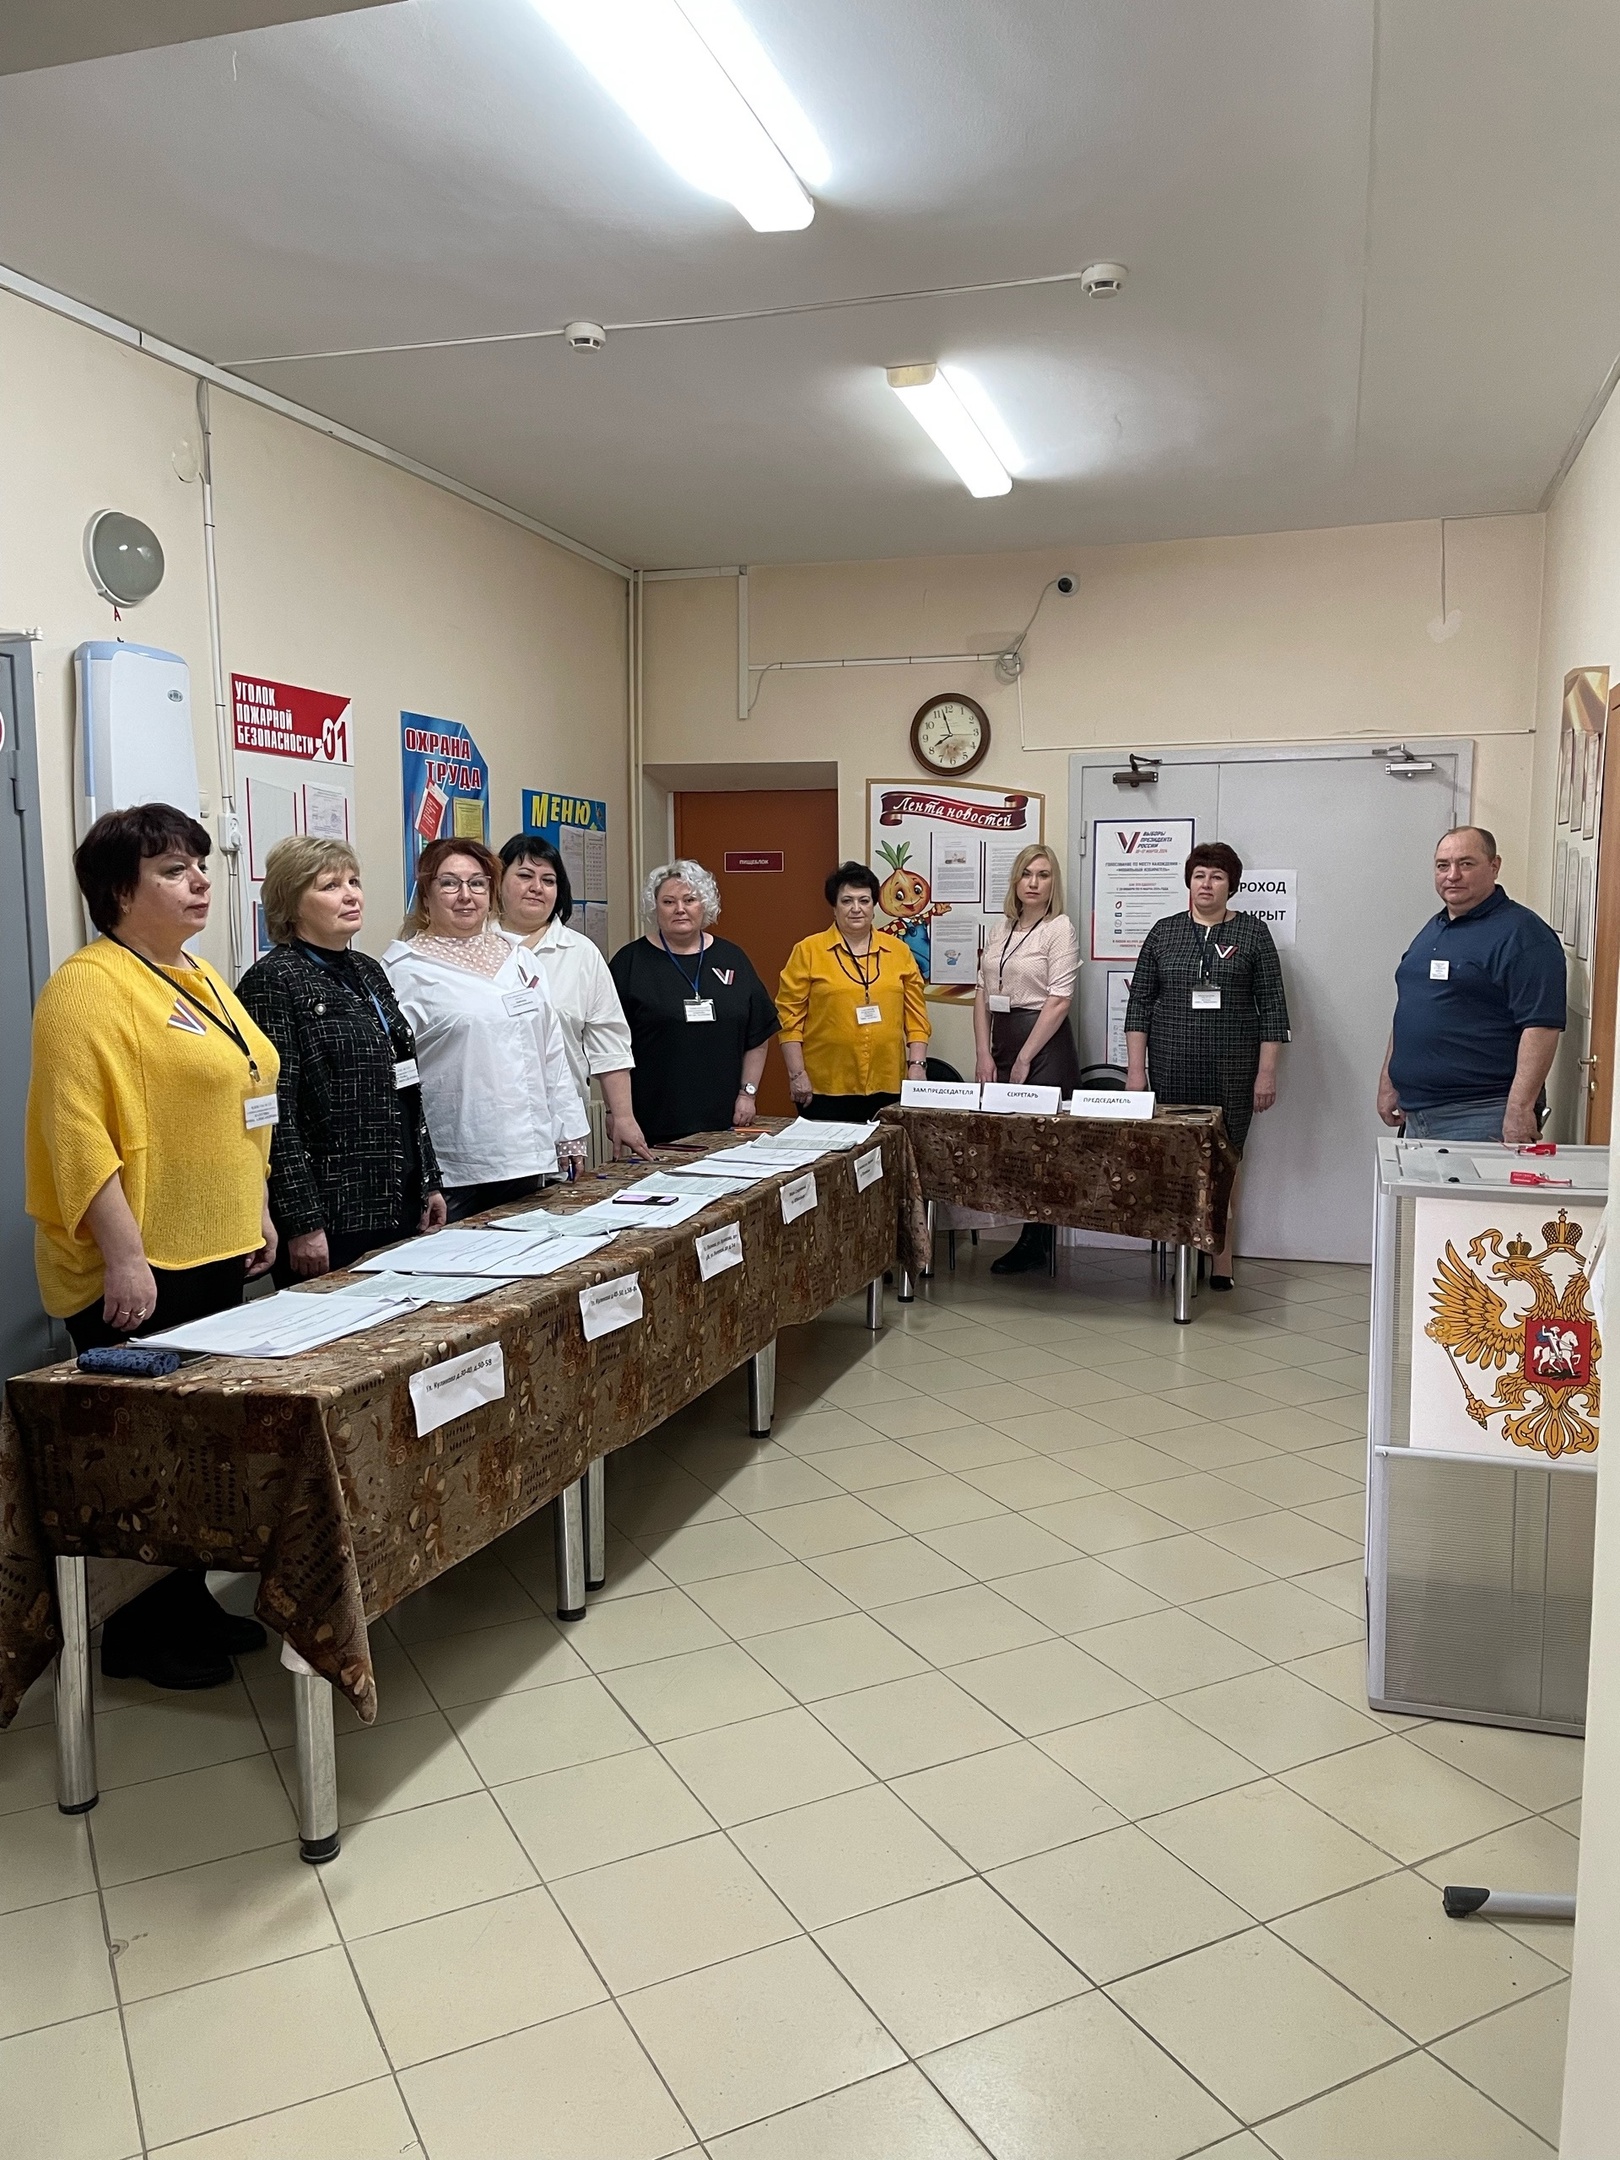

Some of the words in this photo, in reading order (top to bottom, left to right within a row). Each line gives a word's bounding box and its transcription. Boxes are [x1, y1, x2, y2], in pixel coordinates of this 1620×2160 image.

[234, 680, 275, 706] УГОЛОК
[944, 704, 954, 714] 12
[960, 707, 964, 715] 1
[236, 703, 292, 730] ПОЖАРНОЙ
[933, 710, 941, 718] 11
[969, 716, 974, 725] 2
[925, 721, 934, 730] 10
[973, 728, 979, 736] 3
[237, 725, 314, 754] БЕЗОПАСНОСТИ
[922, 734, 929, 743] 9
[405, 727, 471, 761] ОХРАНА
[970, 741, 976, 750] 4
[938, 755, 944, 763] 7
[962, 752, 968, 760] 5
[950, 757, 956, 766] 6
[425, 760, 481, 790] ТРУДА
[893, 797, 944, 815] Лента
[946, 807, 1013, 827] новостей
[1240, 882, 1286, 894] РОХОД
